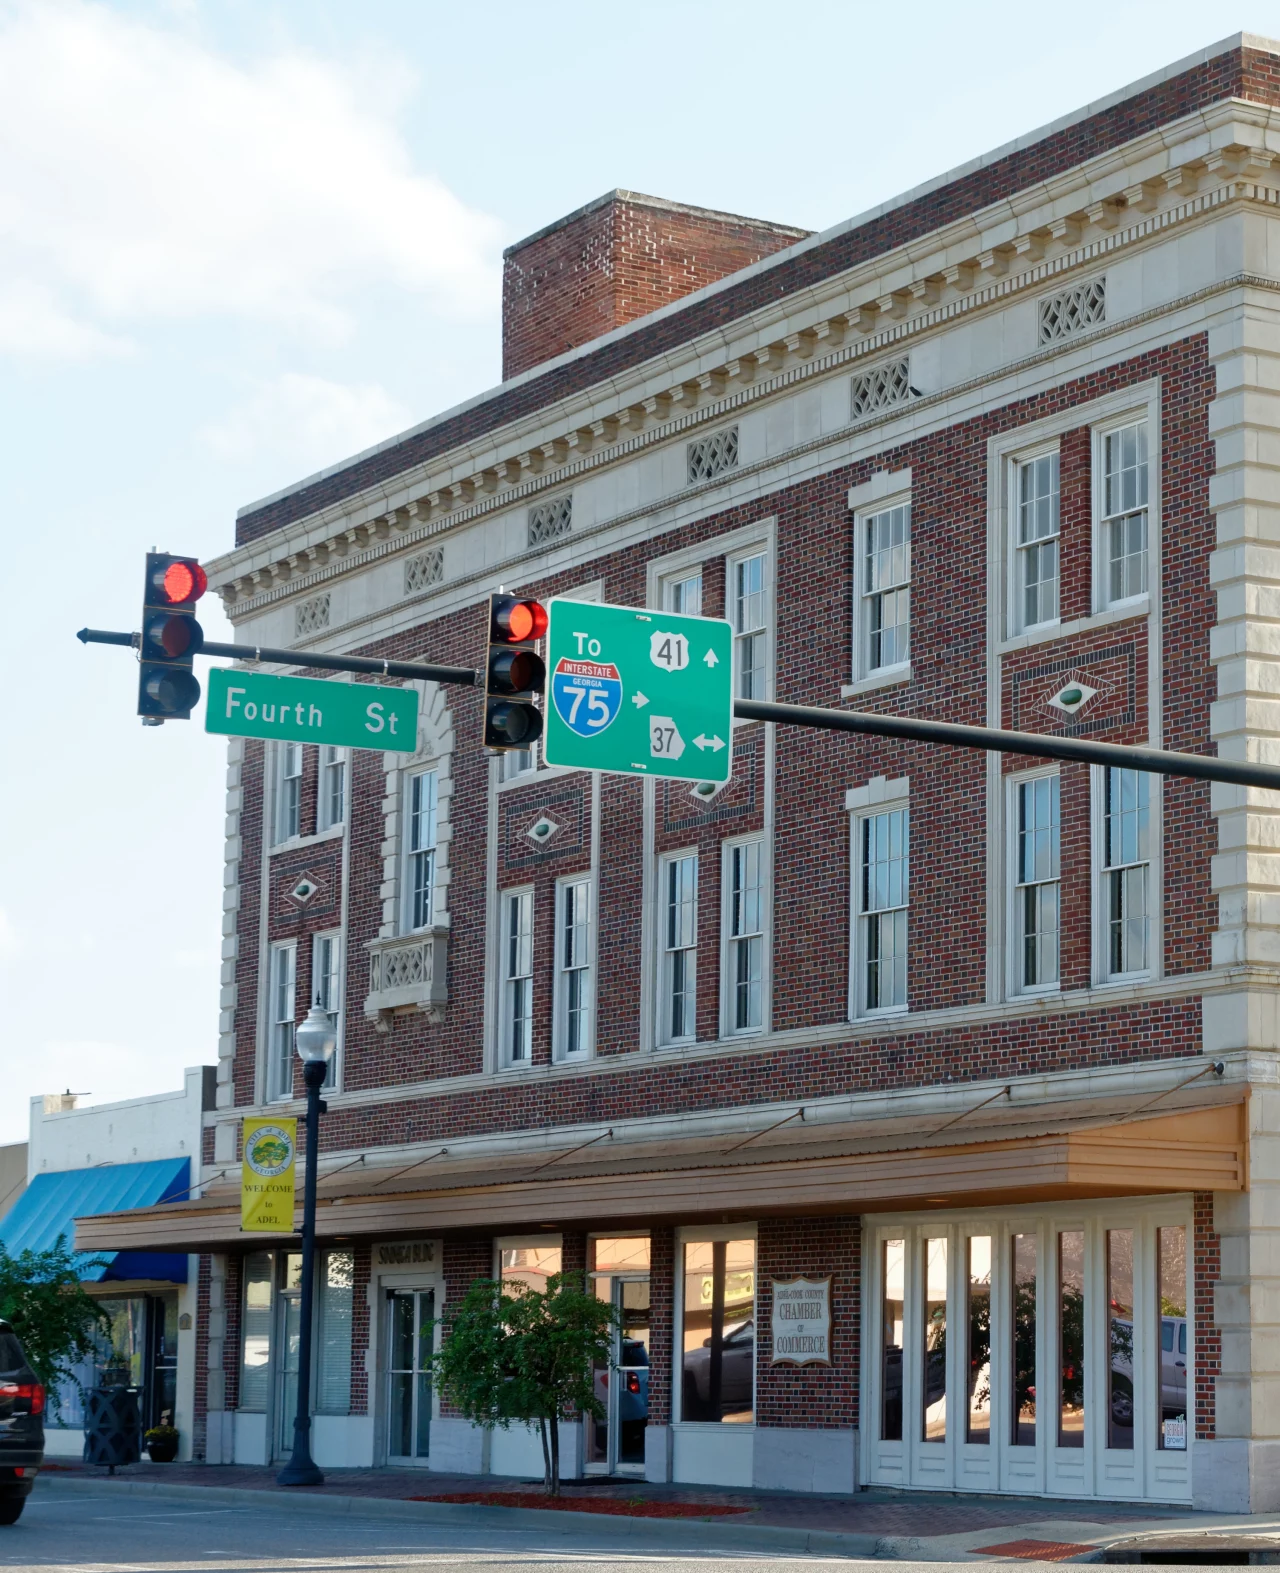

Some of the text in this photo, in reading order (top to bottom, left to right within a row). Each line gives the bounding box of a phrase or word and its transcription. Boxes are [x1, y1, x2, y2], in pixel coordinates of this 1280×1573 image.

[573, 631, 601, 657] To
[657, 638, 682, 667] 41
[564, 662, 612, 678] INTERSTATE
[572, 677, 602, 688] GEORGIA
[225, 686, 399, 735] Fourth St
[563, 686, 610, 727] 75
[652, 727, 675, 753] 37
[254, 1165, 287, 1176] GEORGIA
[244, 1185, 292, 1193] WELCOME
[256, 1216, 280, 1224] ADEL
[777, 1289, 824, 1300] ADEL-COOK COUNTY
[780, 1302, 822, 1320] CHAMBER
[797, 1324, 804, 1332] OF
[777, 1336, 825, 1354] COMMERCE
